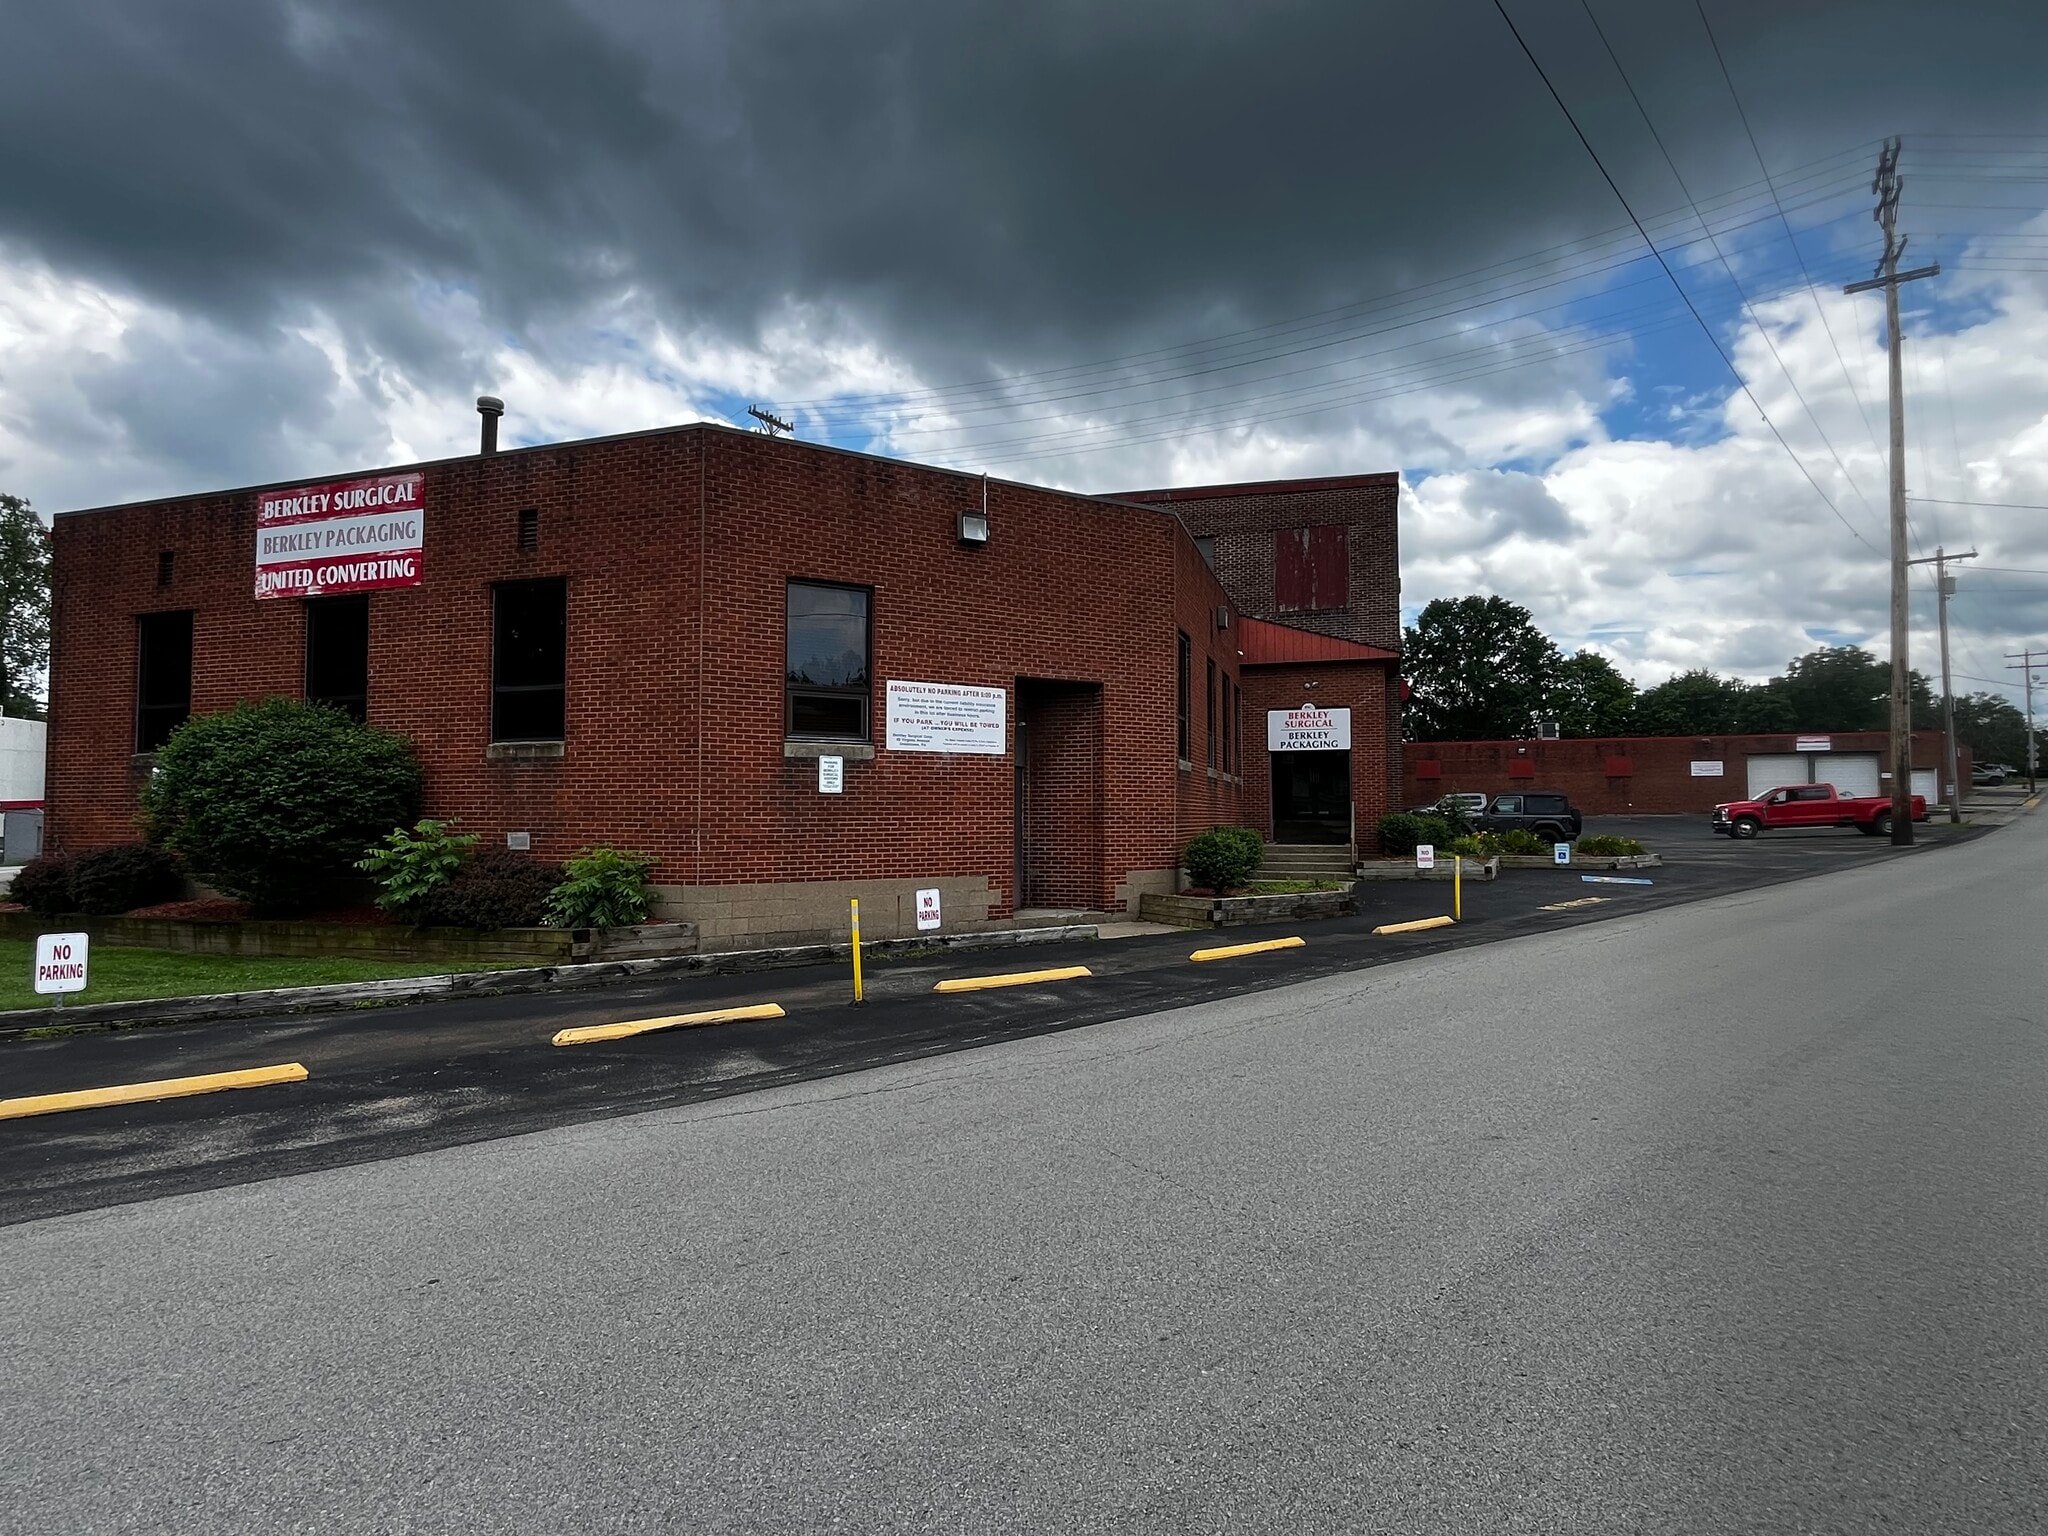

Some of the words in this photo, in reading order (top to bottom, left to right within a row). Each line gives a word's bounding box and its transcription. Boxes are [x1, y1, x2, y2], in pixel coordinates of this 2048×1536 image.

[264, 494, 330, 519] BERKLEY
[333, 482, 416, 511] SURGICAL
[263, 531, 322, 555] BERKLEY
[325, 520, 416, 548] PACKAGING
[261, 568, 313, 591] UNITED
[316, 557, 416, 586] CONVERTING
[890, 685, 926, 694] ABSOLUTELY
[1288, 711, 1329, 720] BERKLEY
[1284, 719, 1334, 728] SURGICAL
[1288, 731, 1330, 740] BERKLEY
[1280, 740, 1338, 749] PACKAGING
[923, 896, 933, 908] NO
[918, 910, 939, 922] PARKING
[52, 944, 72, 960] NO
[39, 963, 84, 981] PARKING
